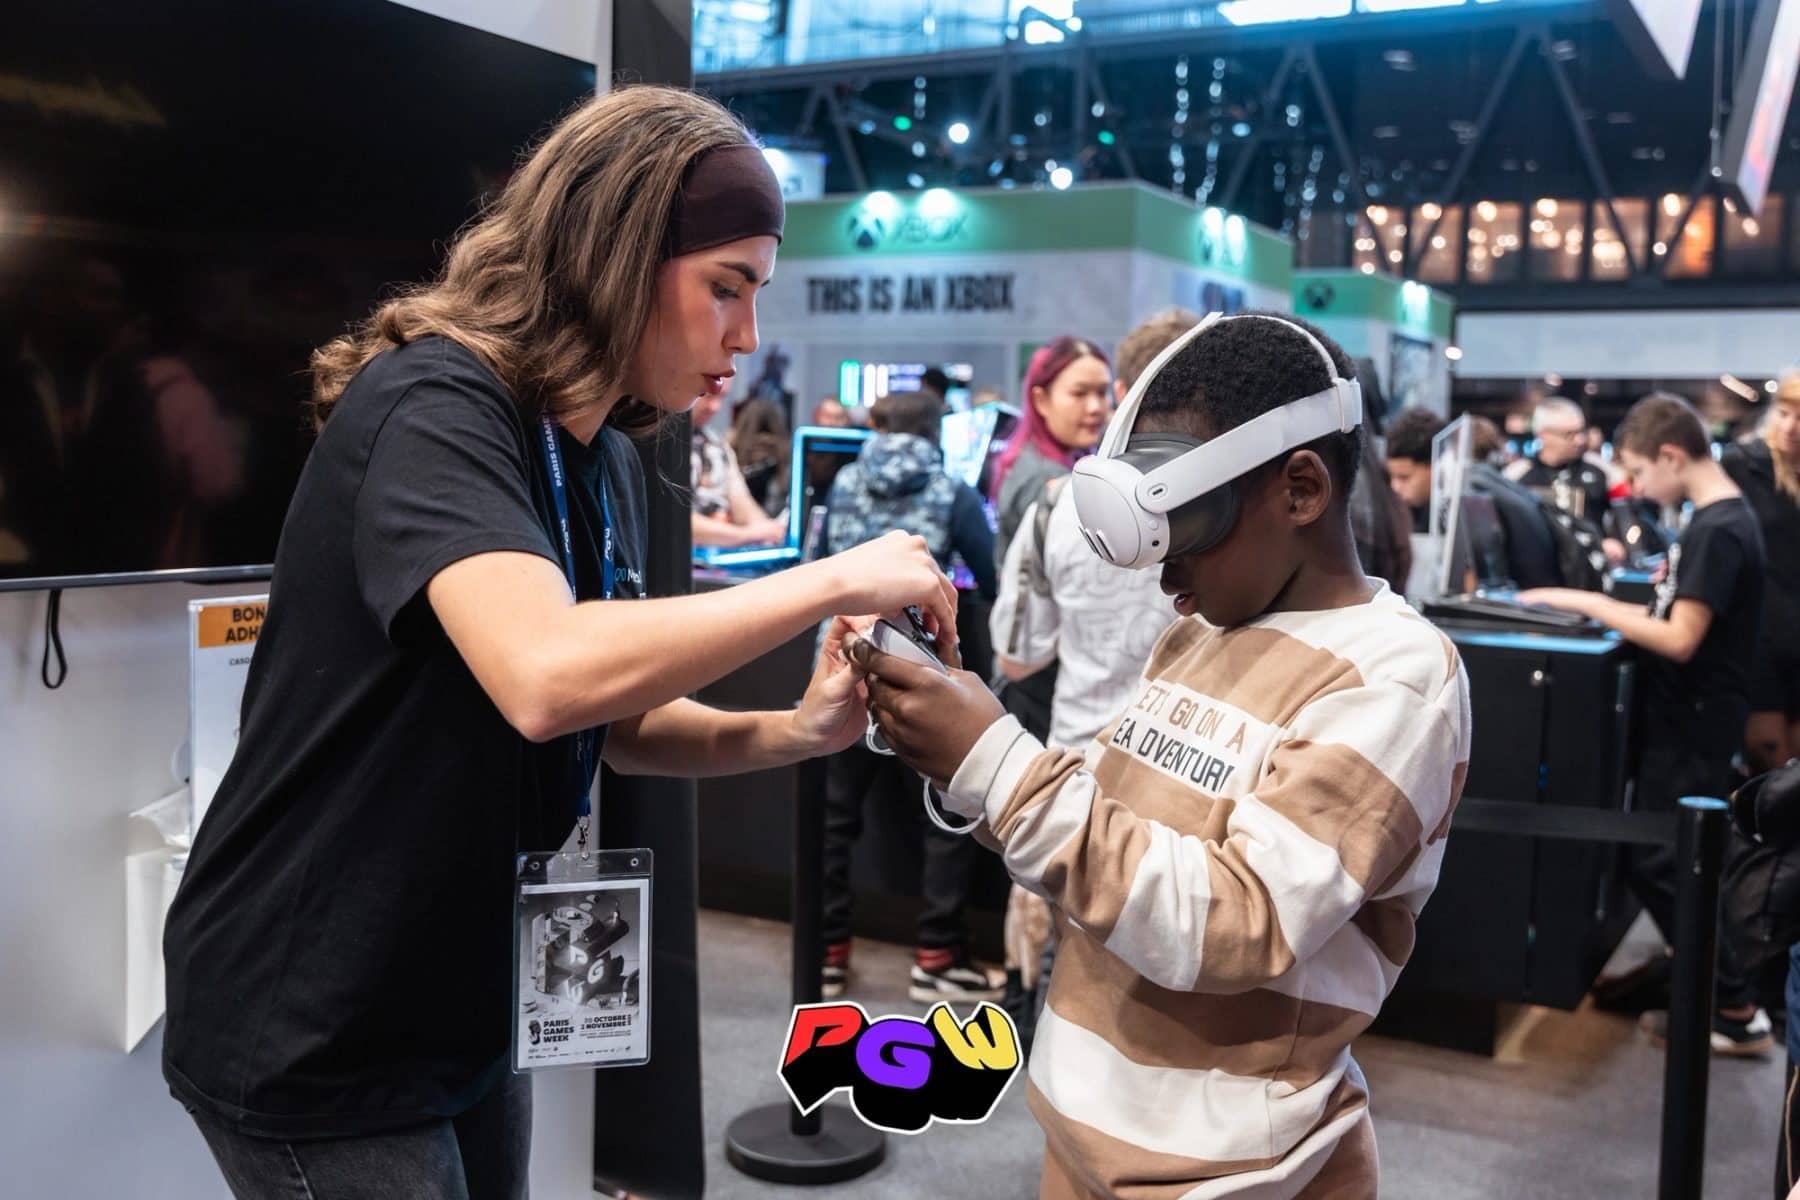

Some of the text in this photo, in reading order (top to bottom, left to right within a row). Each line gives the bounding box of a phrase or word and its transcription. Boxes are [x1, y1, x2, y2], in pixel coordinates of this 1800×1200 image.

[806, 272, 1016, 314] THIS IS AN XBOX
[542, 415, 562, 487] PARIS GAME
[225, 626, 259, 642] ADH
[1169, 697, 1199, 730] GO
[1195, 708, 1226, 741] ON
[1225, 721, 1246, 755] A
[1113, 717, 1235, 793] EA DVENTUR
[544, 1019, 569, 1027] PARIS
[544, 1026, 574, 1035] GAMES
